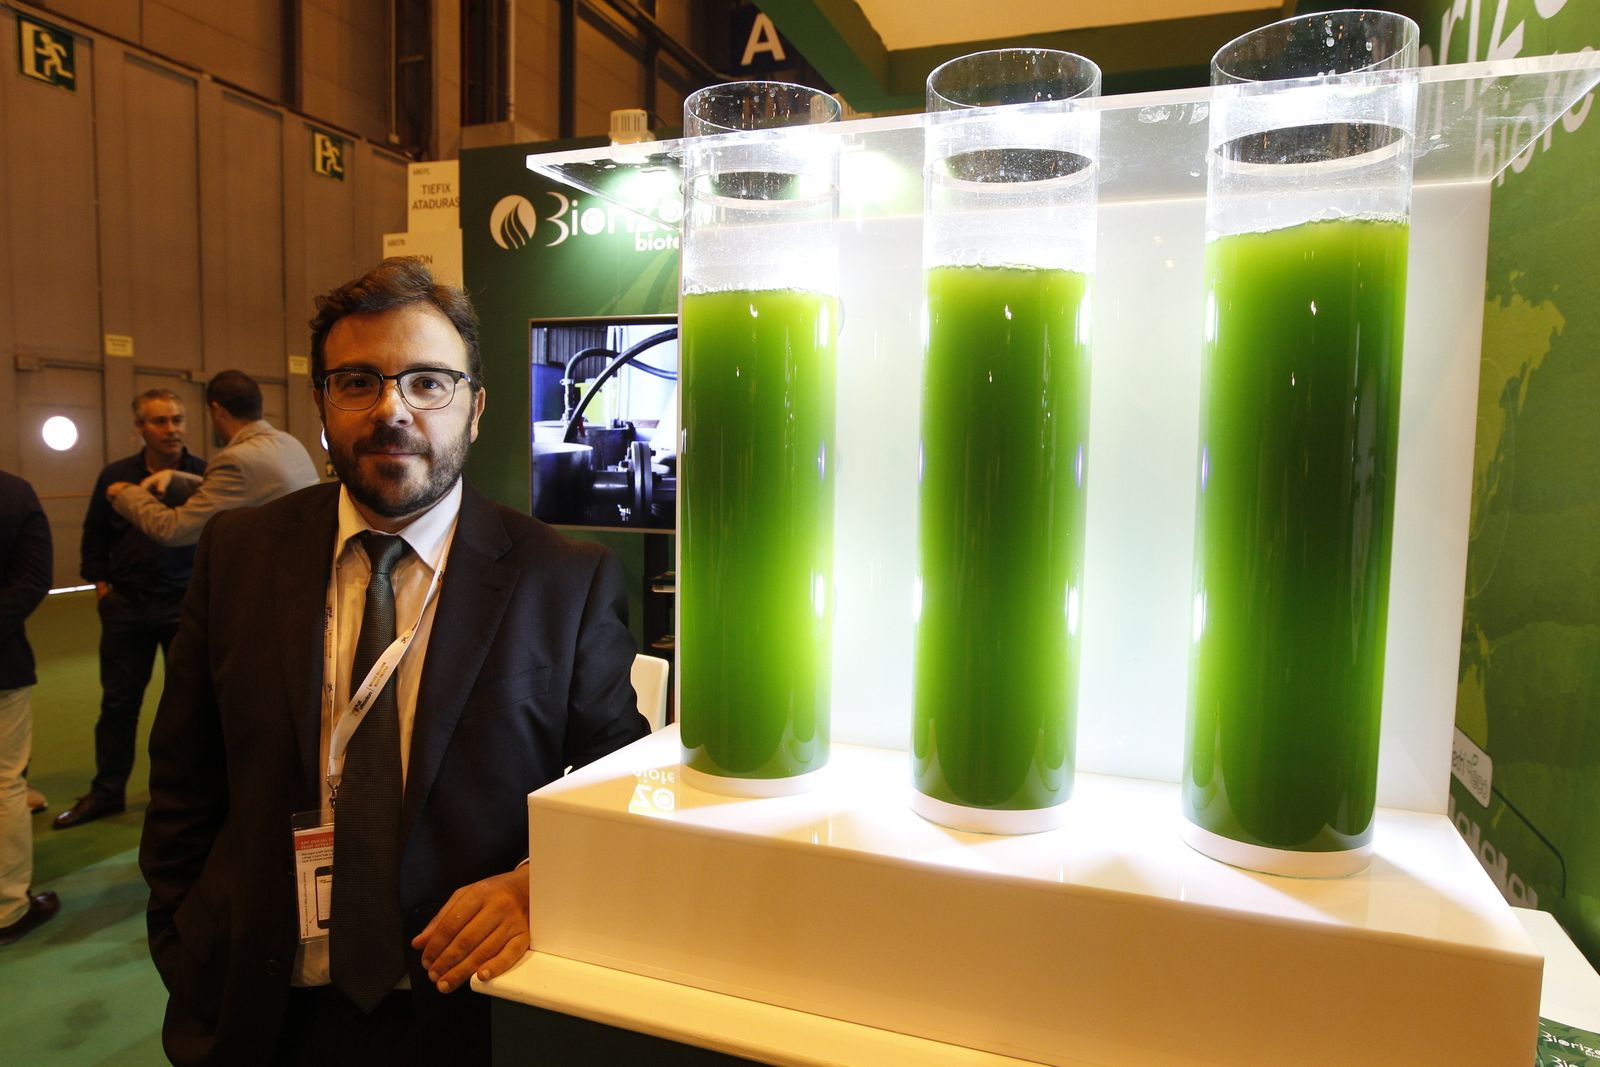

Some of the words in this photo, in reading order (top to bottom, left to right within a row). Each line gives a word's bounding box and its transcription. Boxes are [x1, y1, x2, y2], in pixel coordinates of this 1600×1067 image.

[740, 12, 786, 66] A
[421, 183, 451, 196] TIEFIX
[411, 196, 461, 211] ATADURAS
